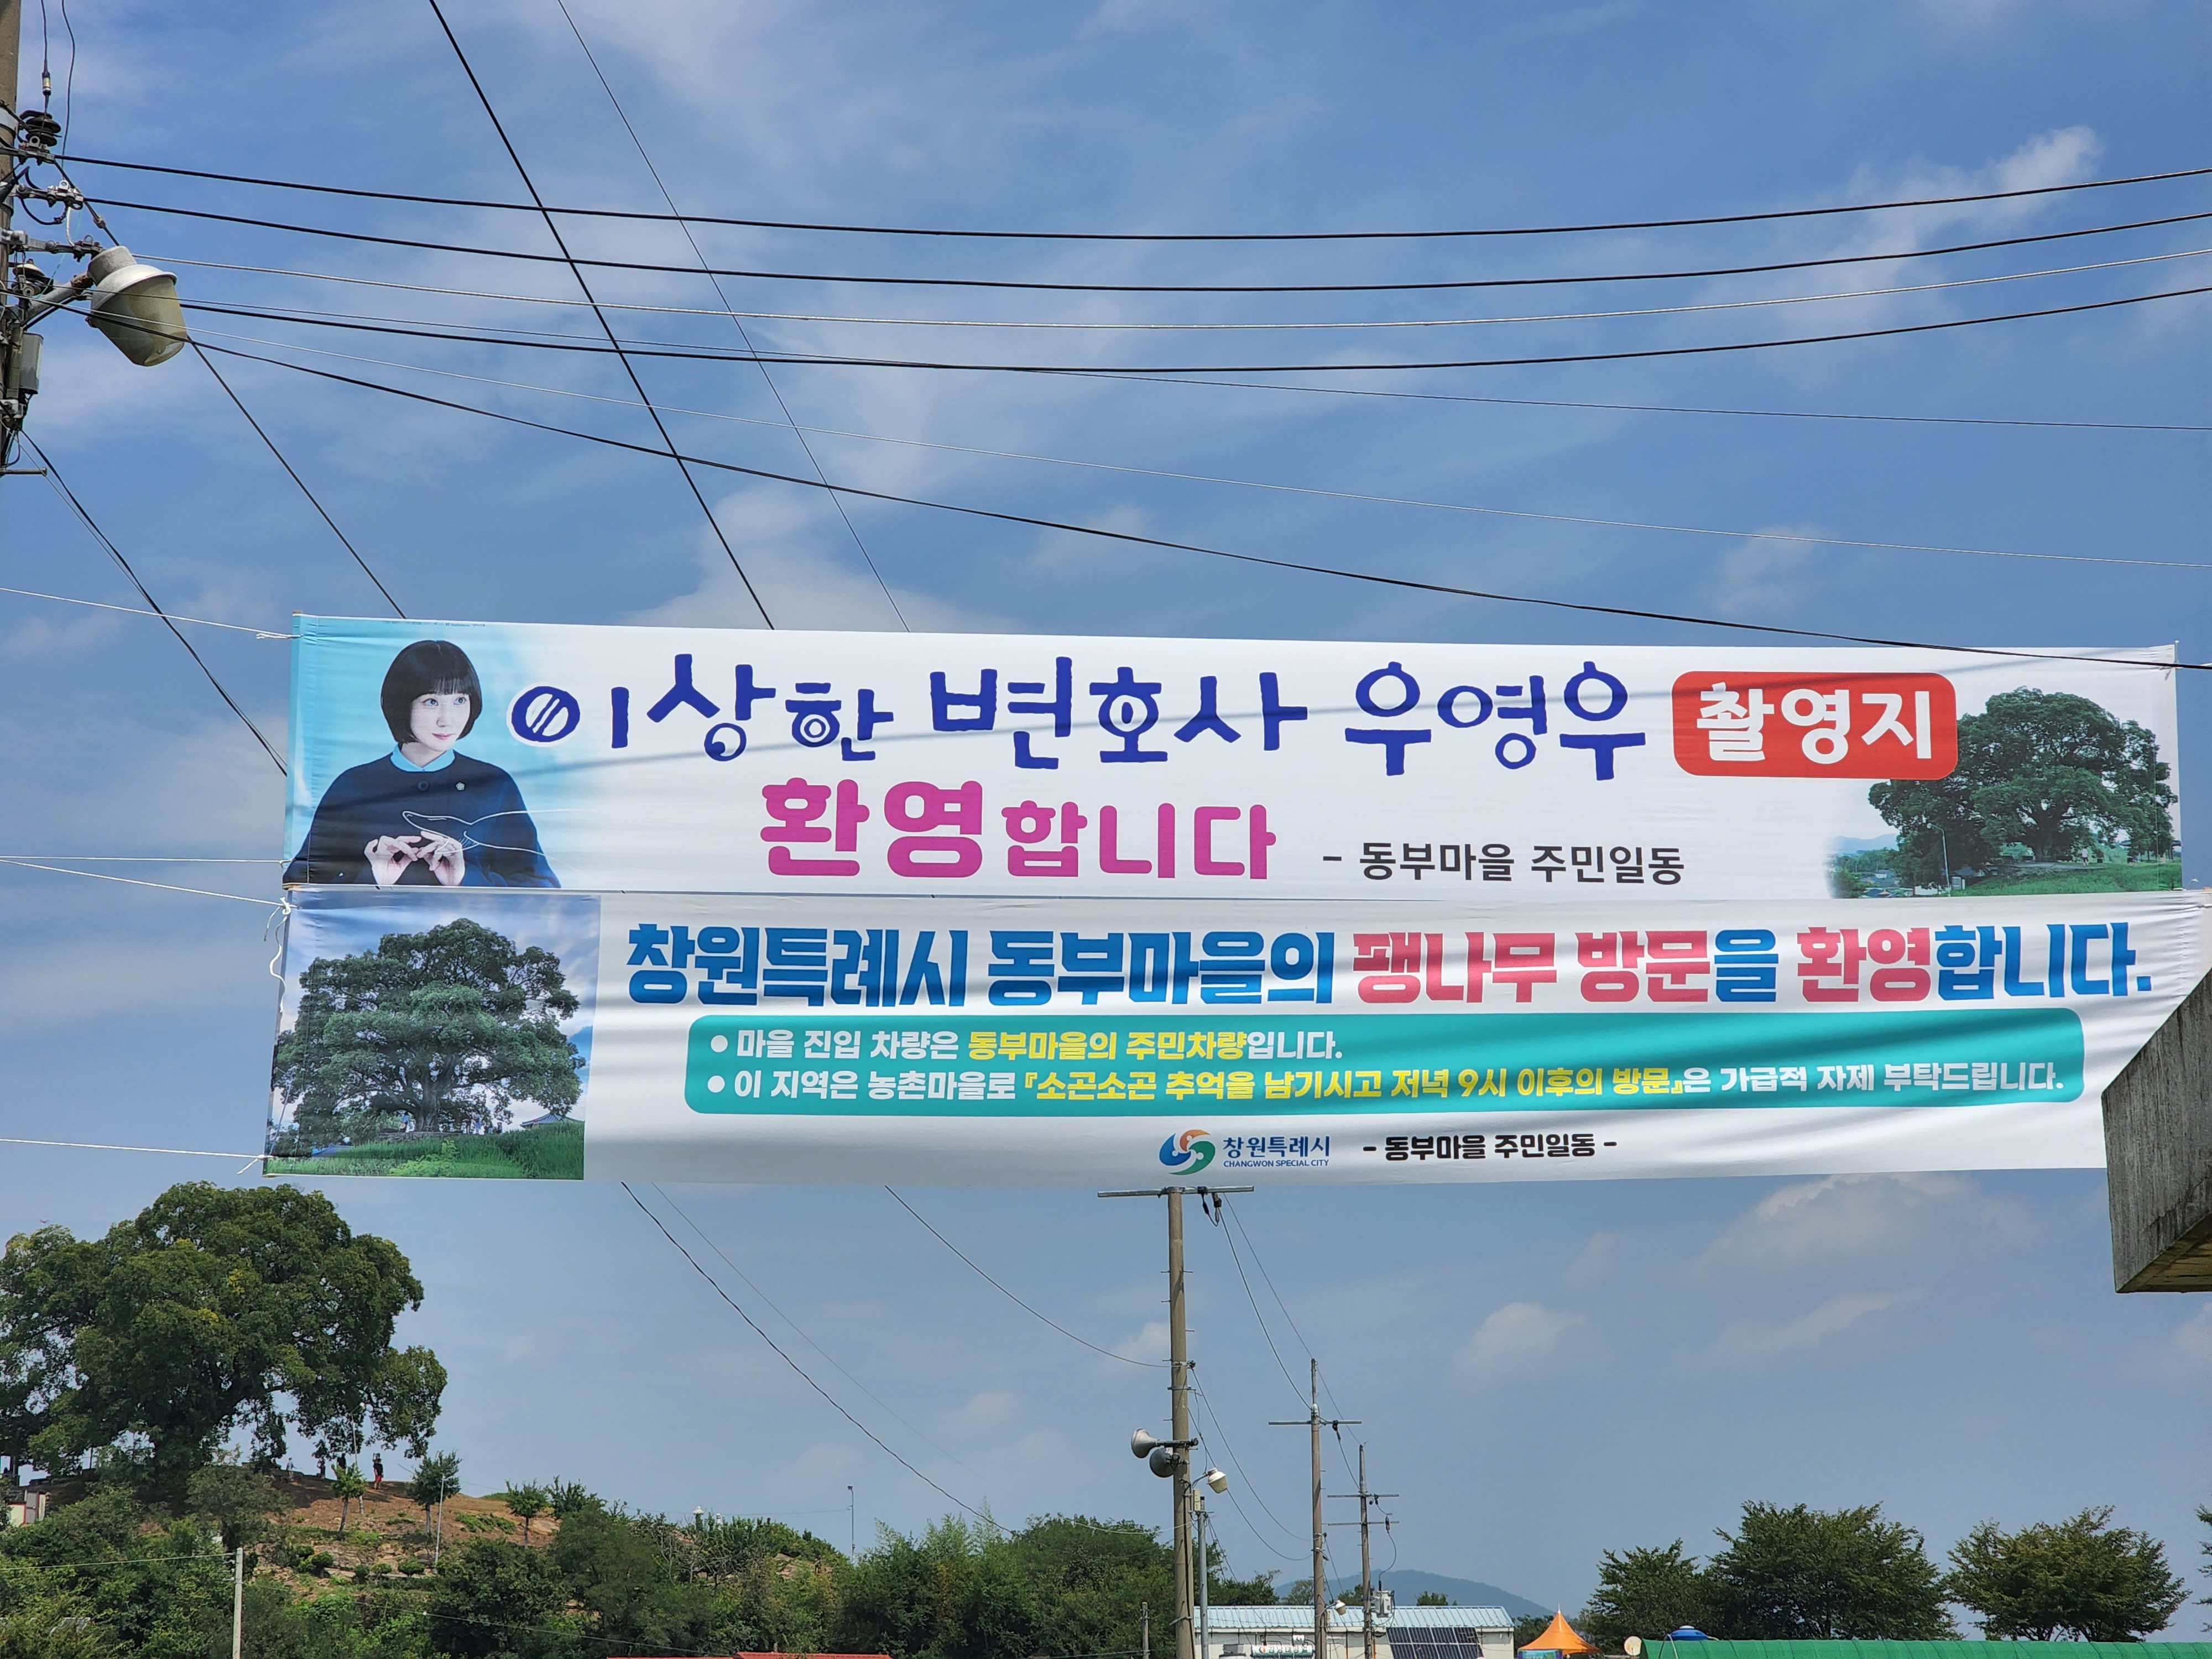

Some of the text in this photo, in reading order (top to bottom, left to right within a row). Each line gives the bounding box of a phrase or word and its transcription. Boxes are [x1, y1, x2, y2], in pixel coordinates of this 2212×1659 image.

[512, 653, 1932, 780] 이상한 변호사 우영우 촬영지
[760, 776, 1277, 879] 환영합니다
[1359, 842, 1515, 882] 동부마을
[1530, 844, 1684, 885] 주민일동
[626, 922, 2152, 1008] 창원특례시 동부마을의 팽나무 방문을 환영합니다.
[735, 1029, 1343, 1062] 마을 진입 차량은 동부마을의 주민차량입니다.
[734, 1070, 761, 1100] 이
[770, 1070, 859, 1100] 지역은
[867, 1071, 1016, 1101] 농촌마을로
[1165, 1070, 1256, 1100] 추억을
[1264, 1069, 1383, 1100] 남기시고
[1390, 1068, 1450, 1099] 저녁
[1458, 1068, 1506, 1098] 9시
[1516, 1067, 1603, 1098] 이후의
[1720, 1065, 1807, 1092] 가급적
[1815, 1063, 1875, 1092] 자제
[1882, 1061, 2064, 1092] 부탁드립니다.
[1223, 1135, 1330, 1159] 창원특례시
[1384, 1134, 1486, 1162] 동부마을
[1494, 1133, 1597, 1161] 주민일동
